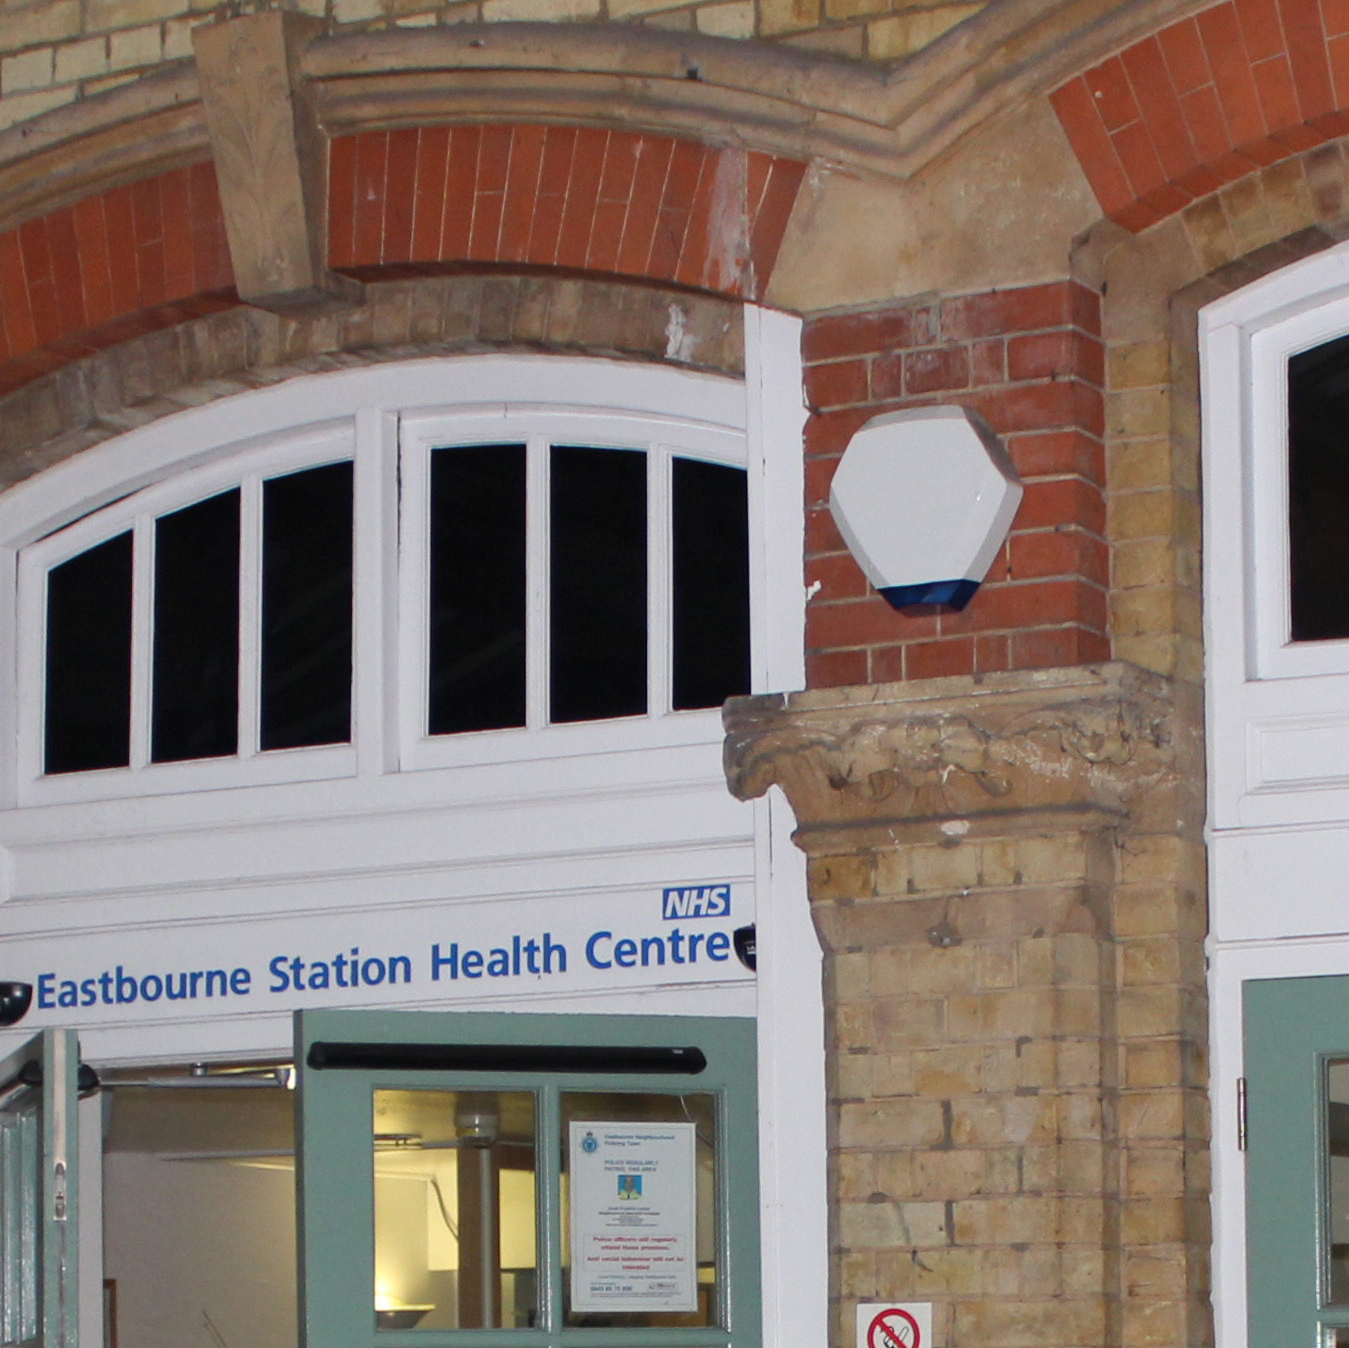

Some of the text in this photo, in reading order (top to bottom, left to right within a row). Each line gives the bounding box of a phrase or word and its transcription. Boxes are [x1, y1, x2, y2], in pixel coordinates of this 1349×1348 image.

[663, 885, 729, 918] NHS
[37, 928, 730, 1009] Eastbourne Station Health Centre
